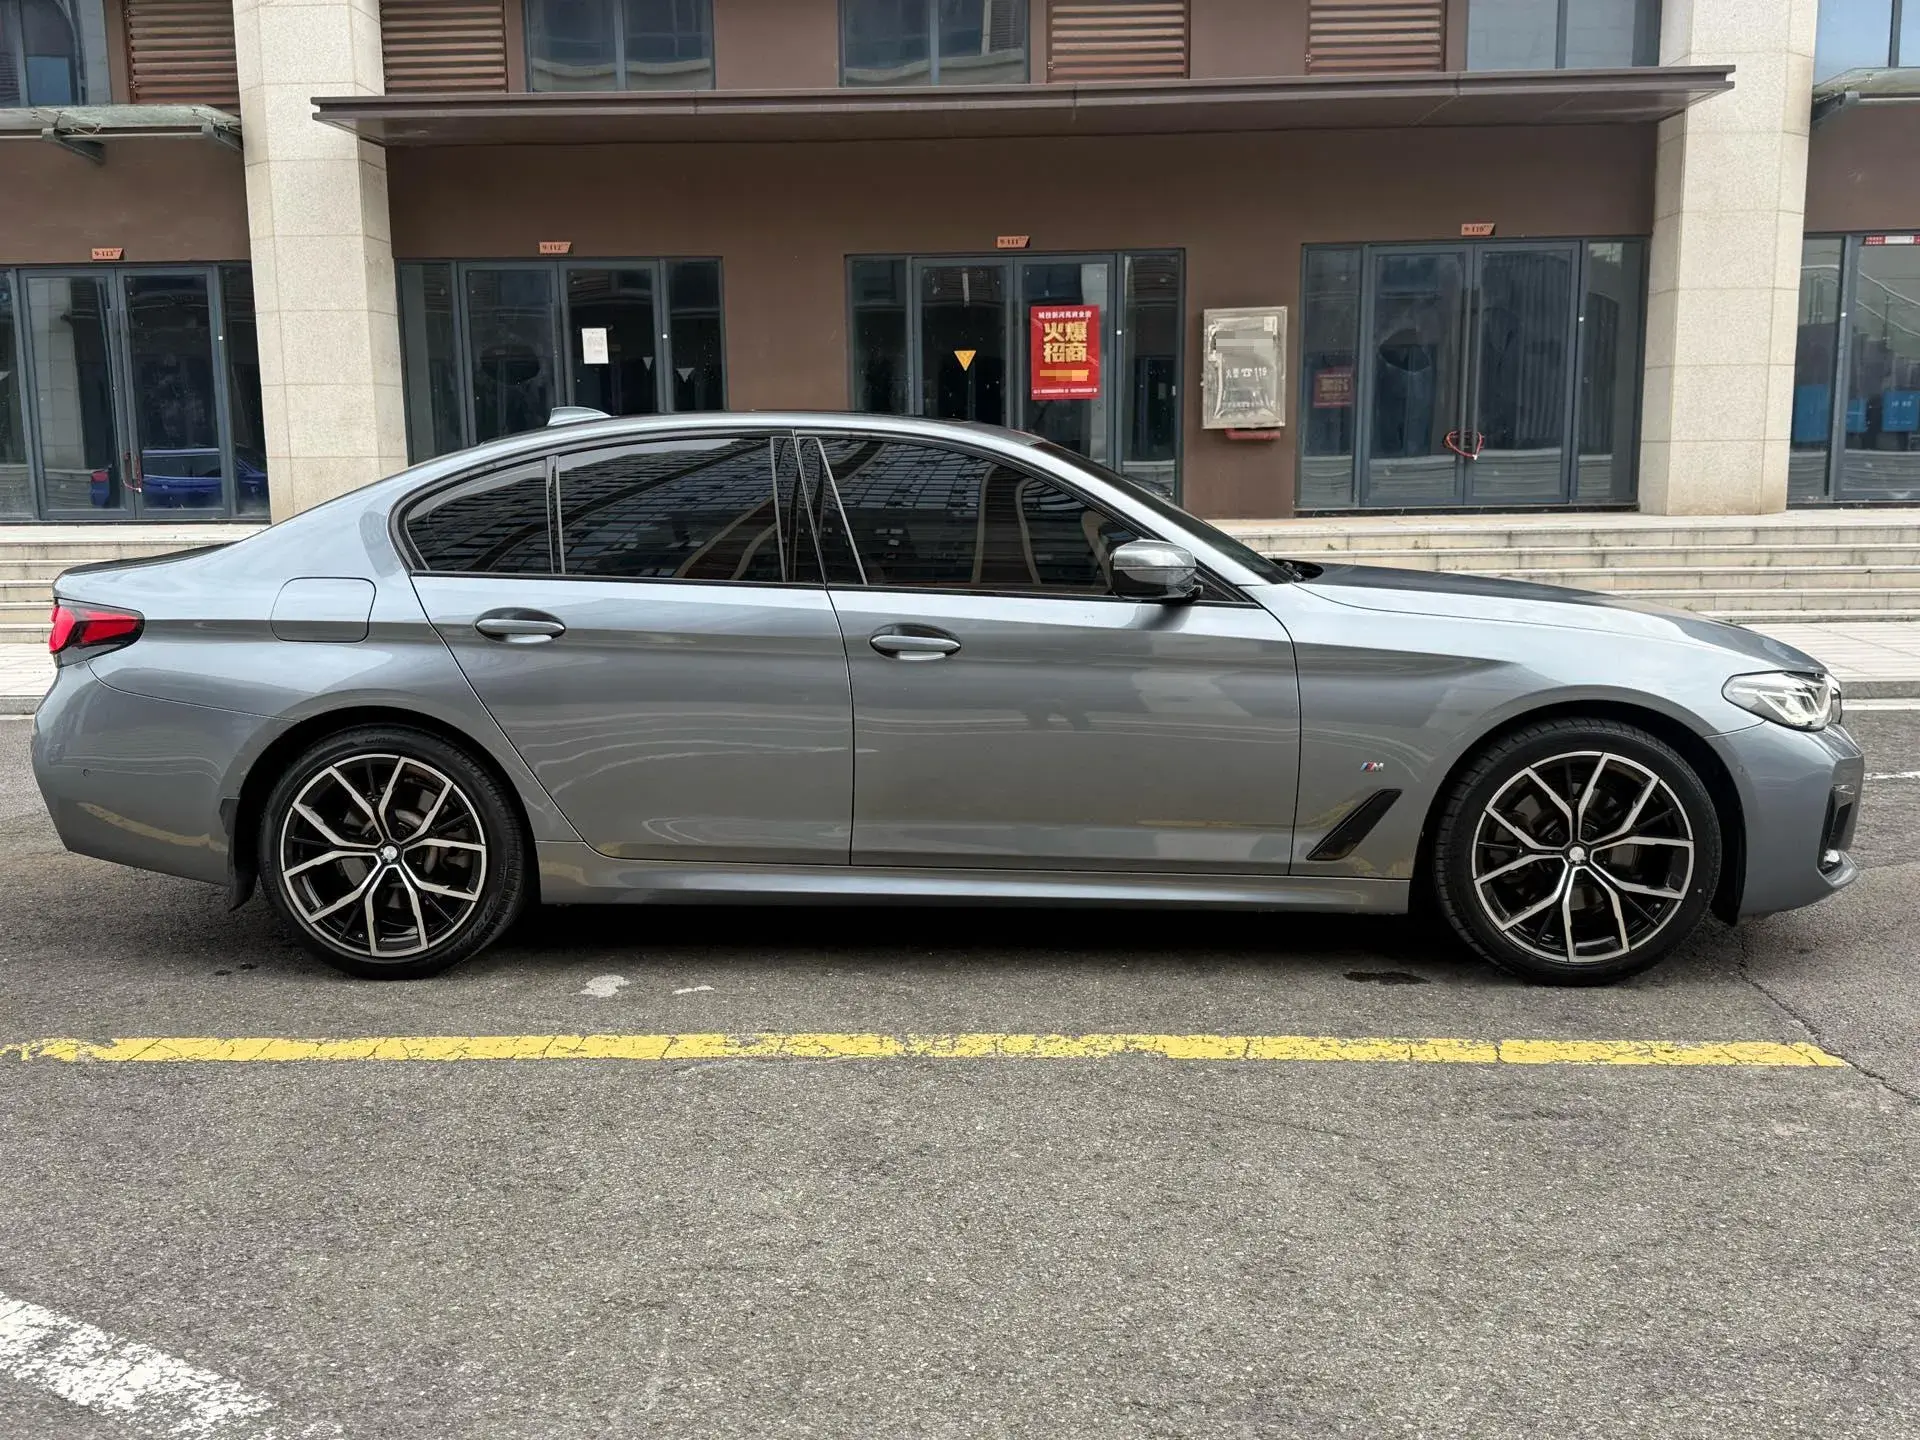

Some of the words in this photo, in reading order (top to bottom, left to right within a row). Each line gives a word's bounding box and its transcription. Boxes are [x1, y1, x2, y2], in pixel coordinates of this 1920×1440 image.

[1043, 321, 1087, 342] 火爆
[1043, 342, 1087, 363] 招商
[1254, 367, 1267, 377] 119
